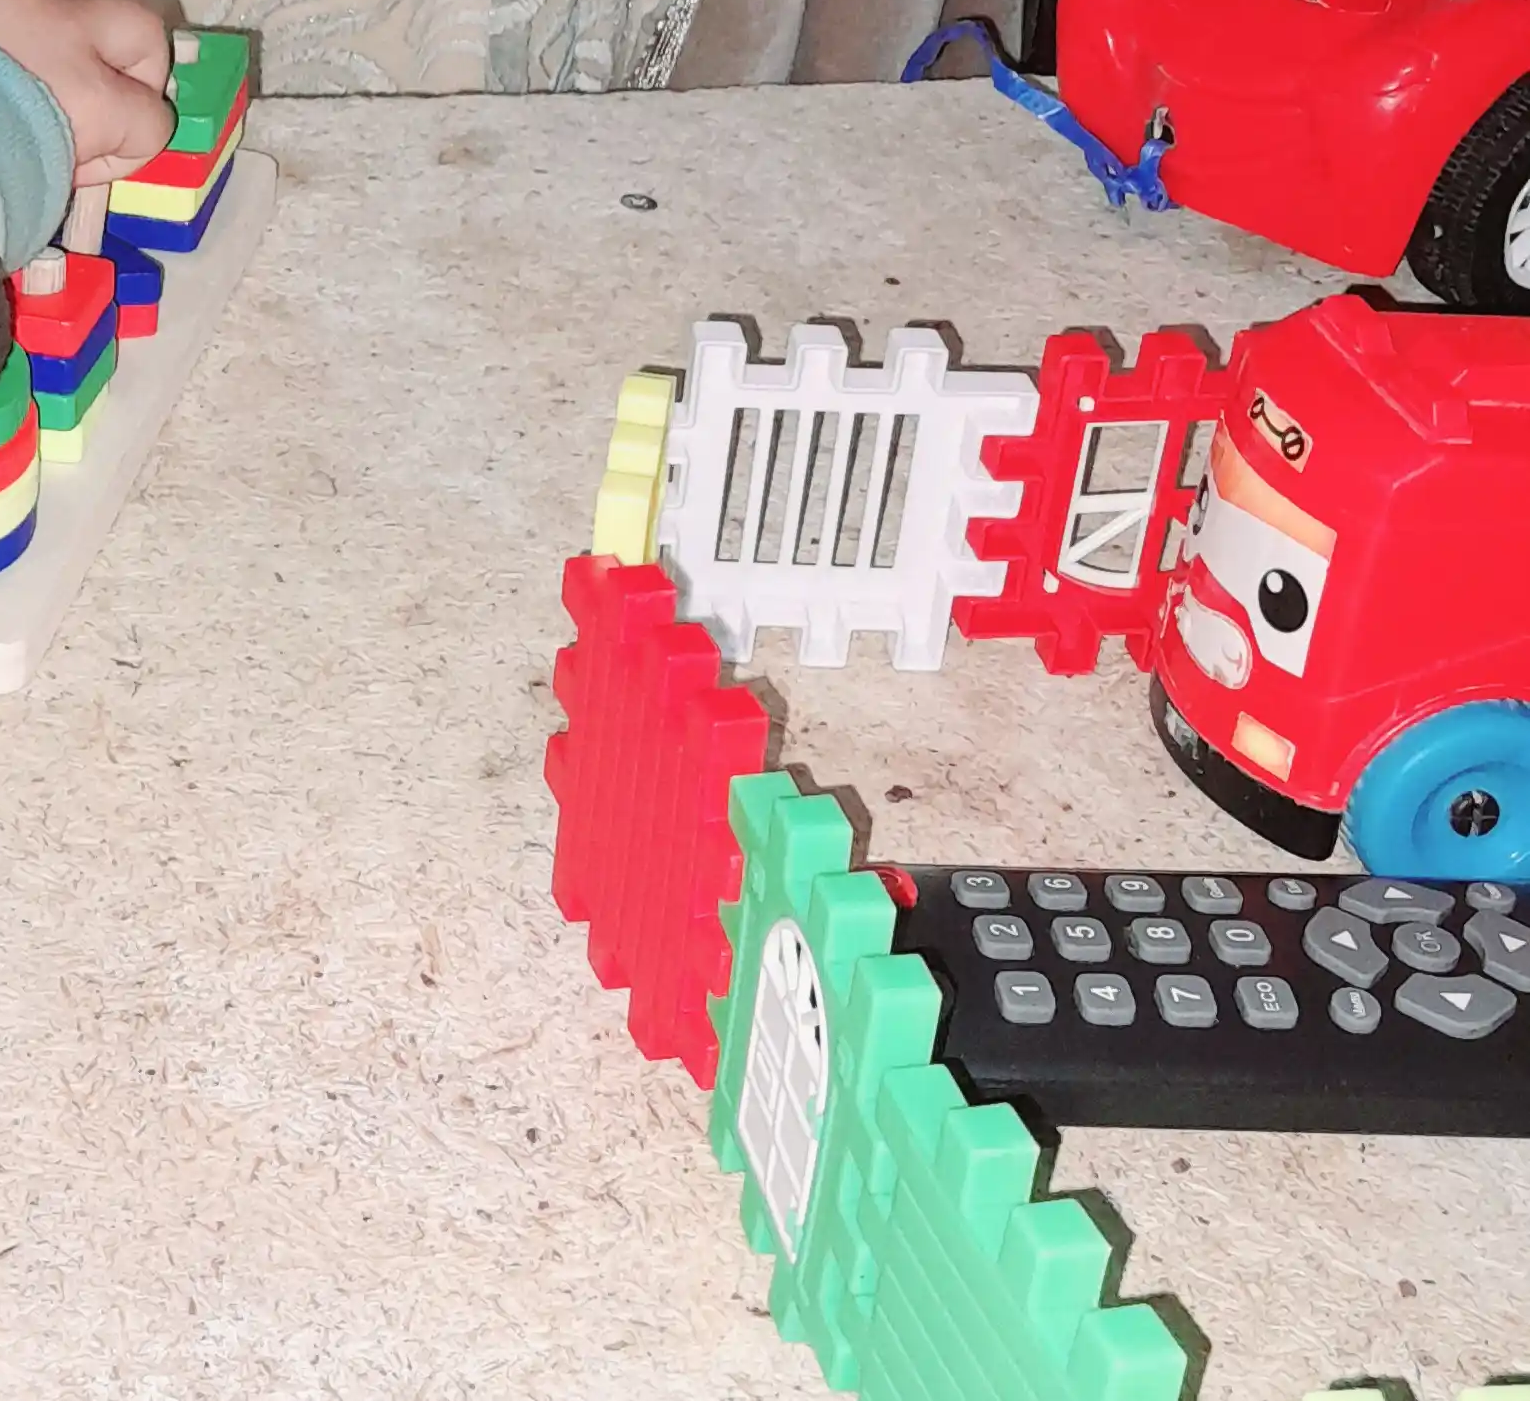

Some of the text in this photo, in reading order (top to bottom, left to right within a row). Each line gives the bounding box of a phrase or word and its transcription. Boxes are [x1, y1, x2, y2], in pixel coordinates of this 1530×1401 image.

[966, 876, 993, 888] 3
[1043, 877, 1072, 890] 6
[1120, 880, 1149, 891] 9
[989, 923, 1019, 937] 2
[1066, 925, 1095, 939] 5
[1146, 926, 1175, 940] 8
[1225, 928, 1255, 942] 0
[1415, 930, 1441, 953] OK
[1011, 985, 1040, 996] 1
[1090, 985, 1119, 1002] 4
[1170, 986, 1201, 1003] 7
[1256, 981, 1280, 1012] ECO
